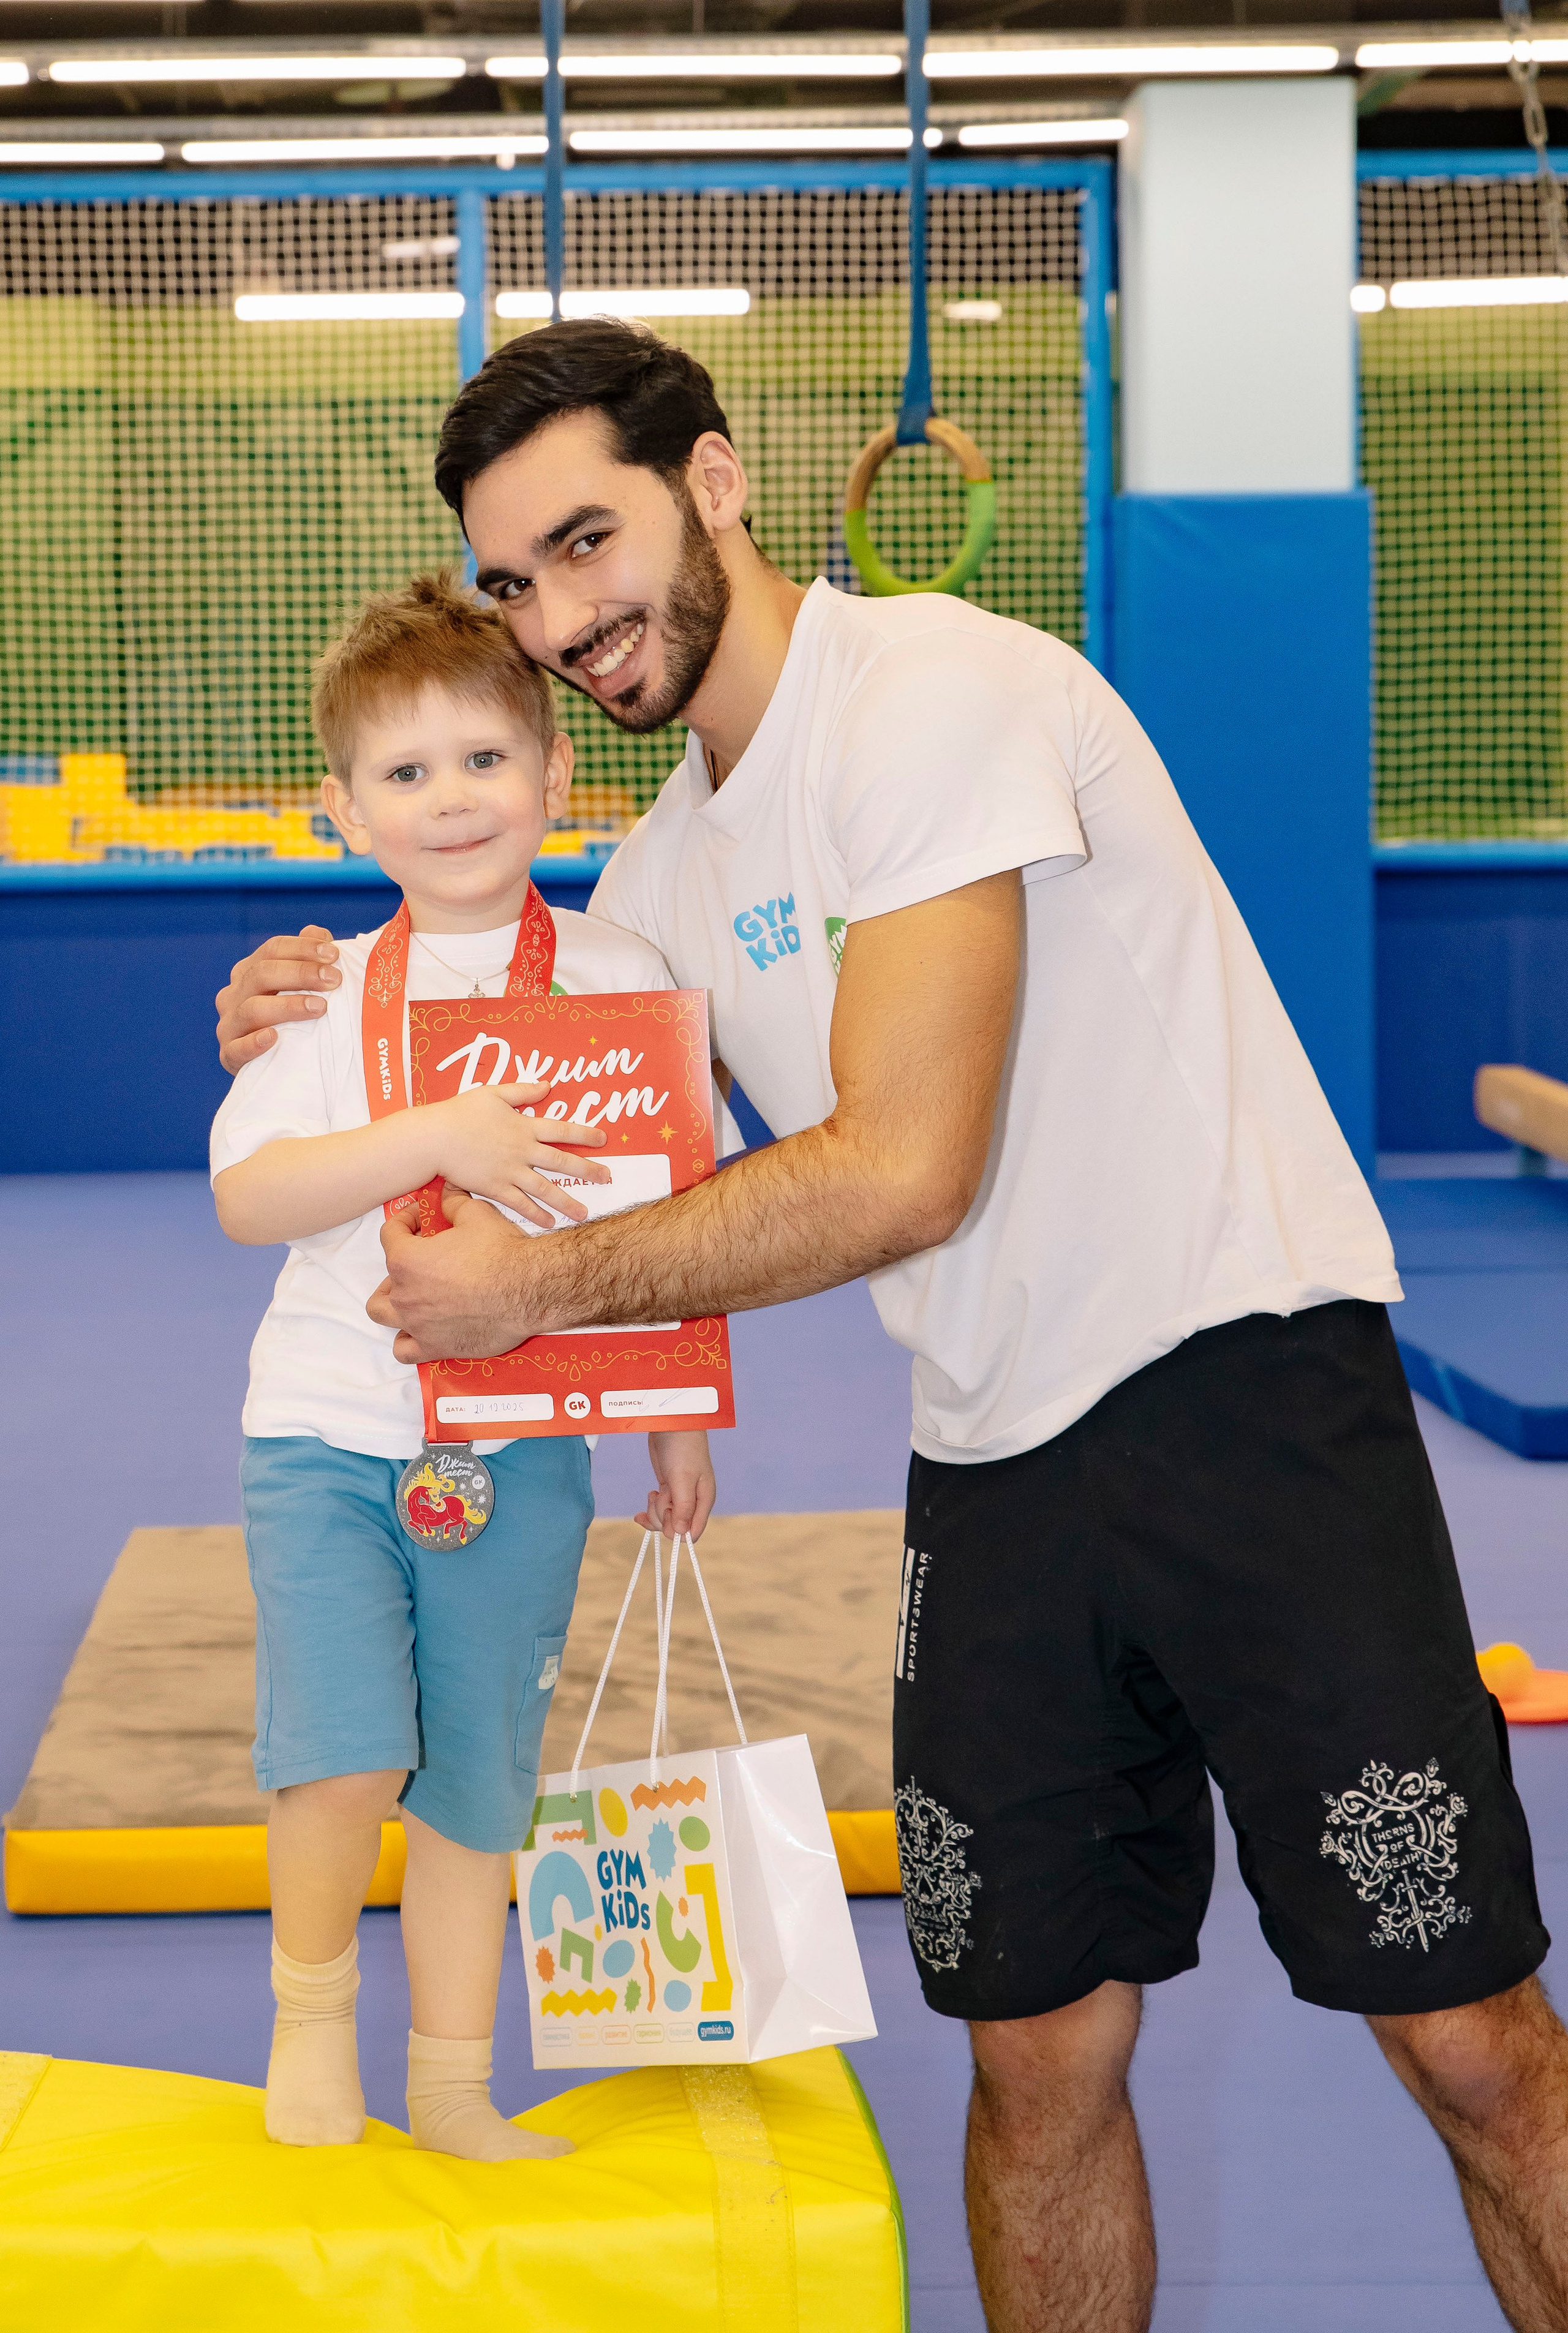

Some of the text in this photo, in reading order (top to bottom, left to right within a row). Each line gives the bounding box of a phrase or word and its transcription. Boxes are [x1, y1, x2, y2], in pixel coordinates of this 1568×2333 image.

[734, 892, 796, 942] GYM
[569, 1400, 586, 1410] GK
[1390, 1841, 1404, 1853] OF
[597, 1849, 647, 1890] GYM
[700, 2025, 731, 2037] gymkids.ru
